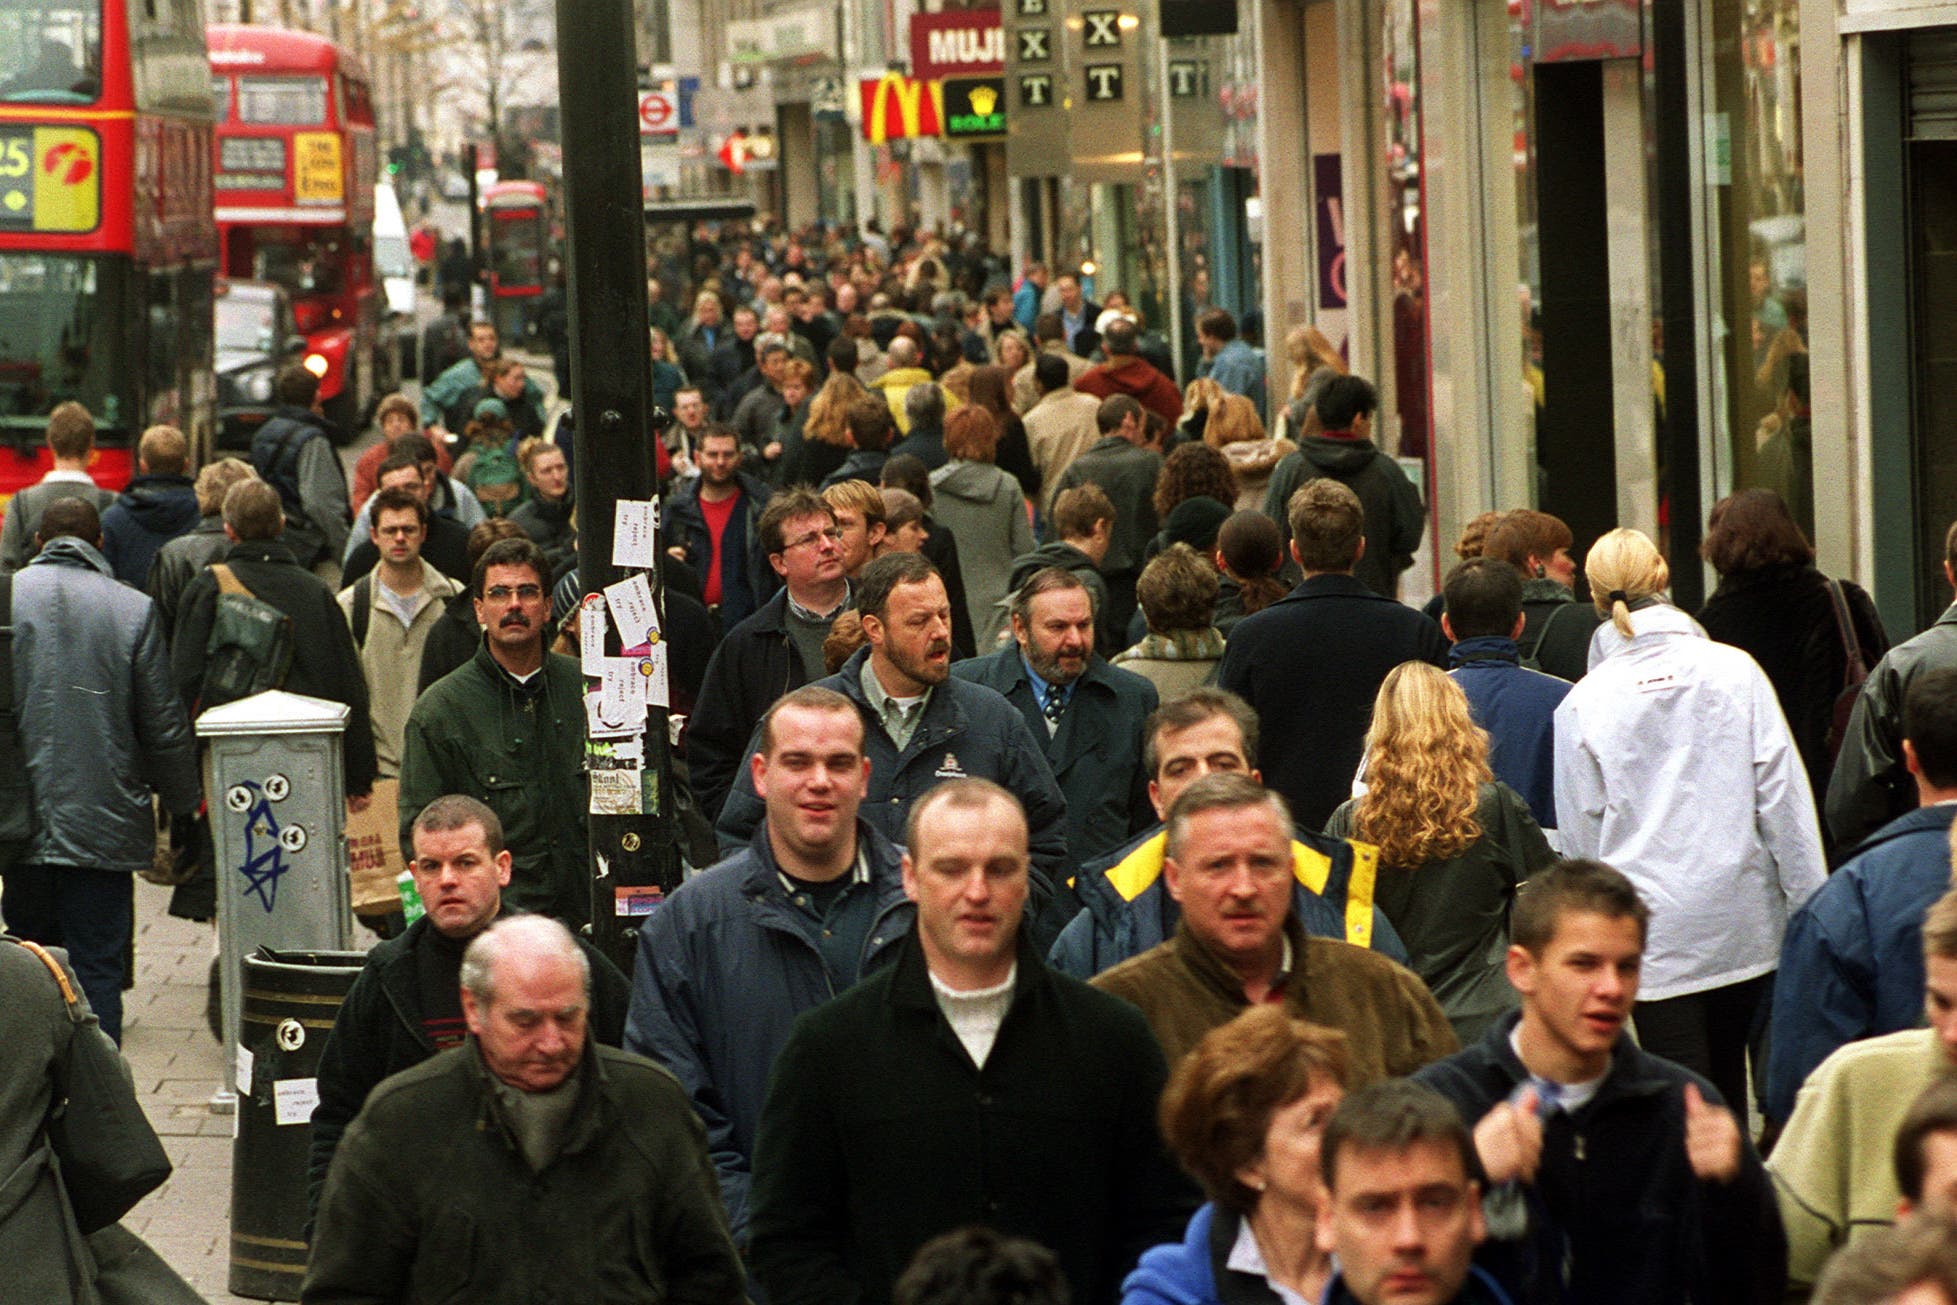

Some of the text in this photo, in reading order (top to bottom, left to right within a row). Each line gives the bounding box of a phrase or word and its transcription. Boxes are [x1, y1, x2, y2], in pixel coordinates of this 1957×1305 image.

[929, 26, 1005, 63] MUJI
[949, 113, 1005, 132] ROLE
[0, 136, 29, 177] 5
